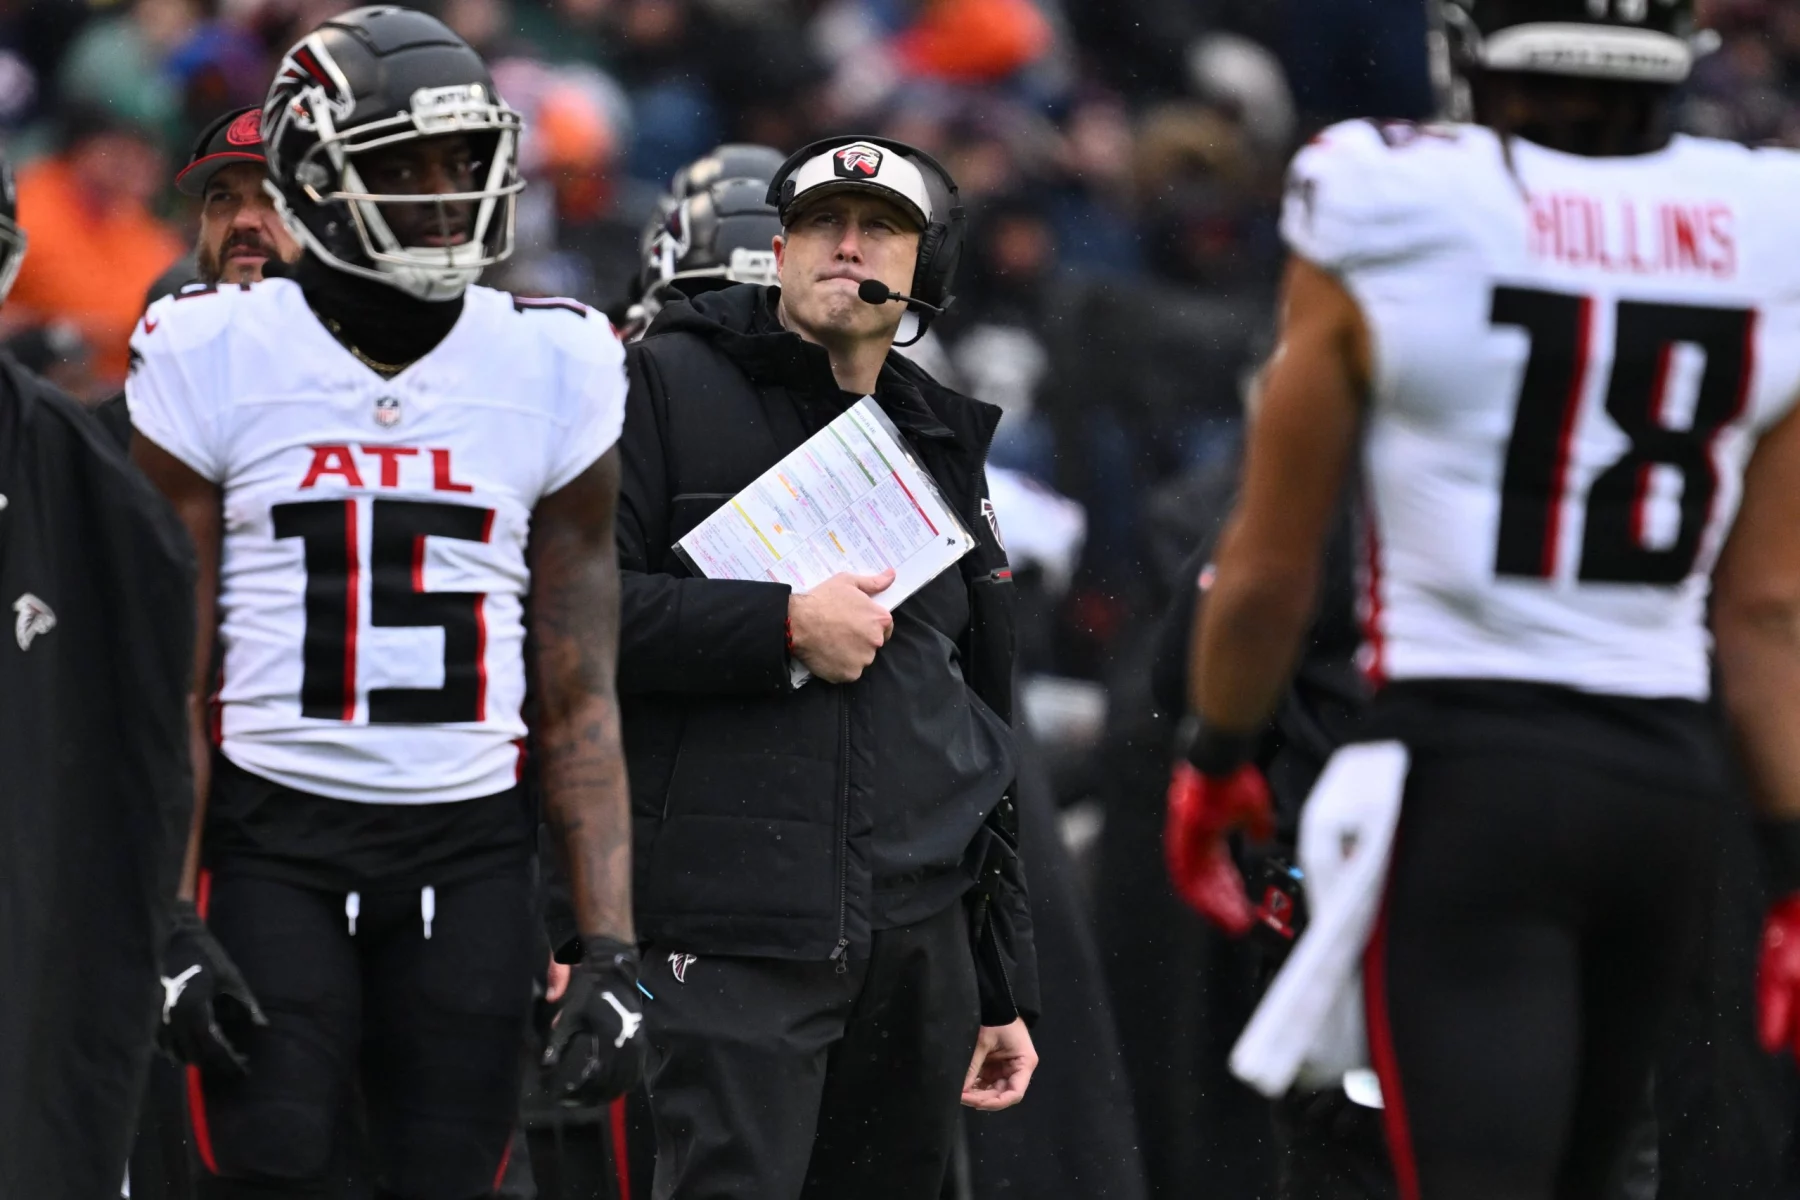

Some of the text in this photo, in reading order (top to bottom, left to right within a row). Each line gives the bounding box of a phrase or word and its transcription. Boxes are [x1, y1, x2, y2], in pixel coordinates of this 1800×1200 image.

[1527, 194, 1736, 279] HOLLINS
[299, 443, 475, 494] ATL
[1490, 285, 1759, 585] 18
[271, 497, 496, 725] 15
